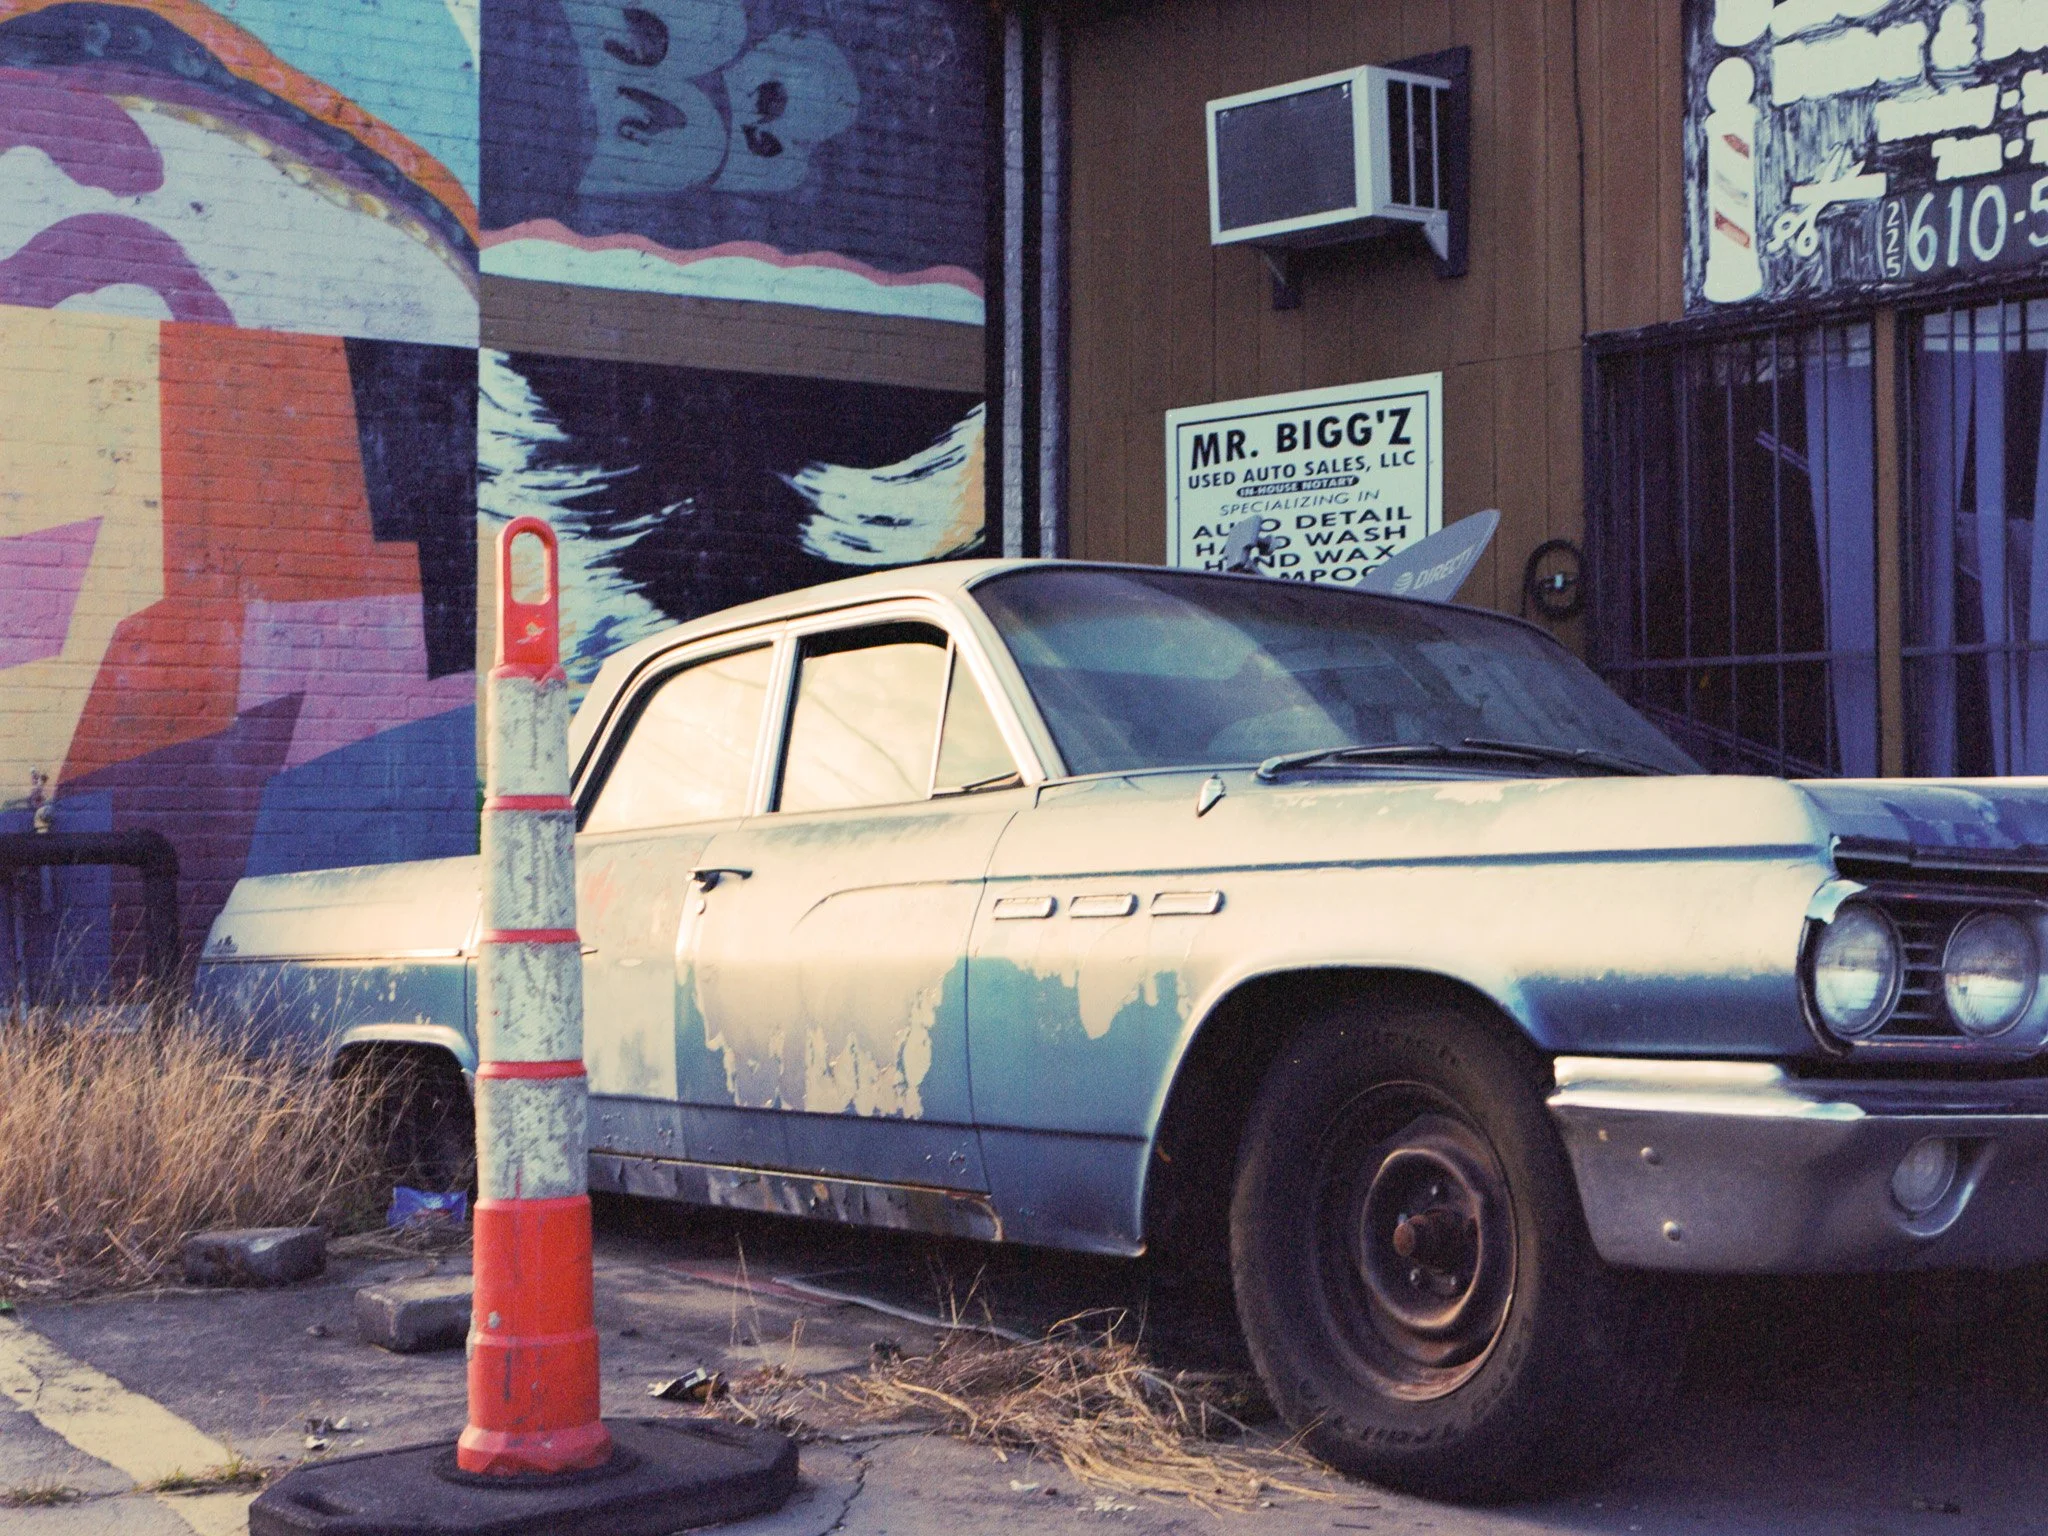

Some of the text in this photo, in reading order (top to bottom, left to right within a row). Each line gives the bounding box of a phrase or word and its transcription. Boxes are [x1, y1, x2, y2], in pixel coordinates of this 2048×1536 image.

[1191, 407, 1412, 471] MR. BIGG'Z
[1188, 450, 1416, 490] USED AUTO SALES, LLC
[1240, 475, 1356, 497] IN-HOUSE NOTARY
[1219, 489, 1380, 516] SPECIALIZING IN
[1193, 505, 1412, 540] AUO DETAIL
[1305, 524, 1407, 547] WASH
[1204, 545, 1396, 573] HND WAX
